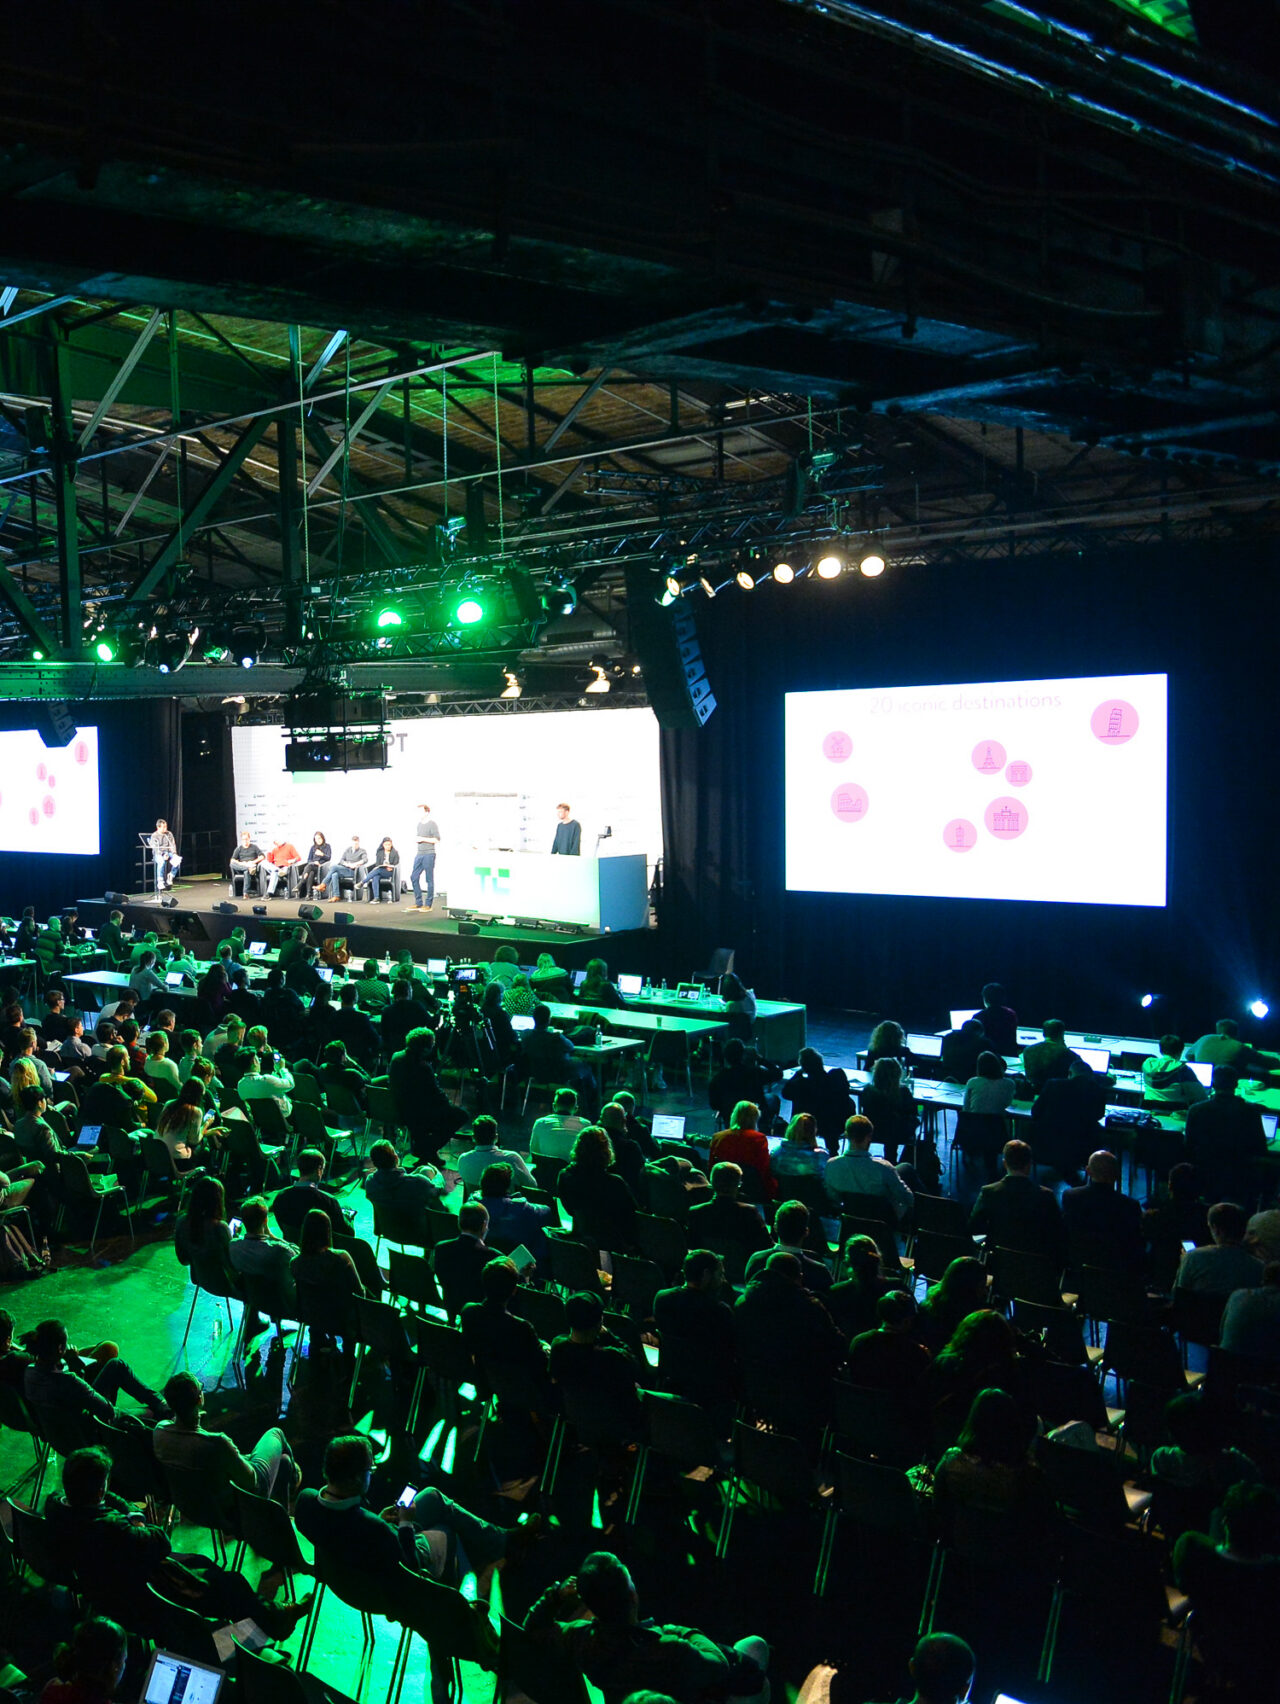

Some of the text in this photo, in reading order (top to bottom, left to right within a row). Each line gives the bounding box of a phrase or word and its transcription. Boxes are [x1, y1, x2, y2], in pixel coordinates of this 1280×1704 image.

[869, 692, 1063, 714] 20 iconic destinations
